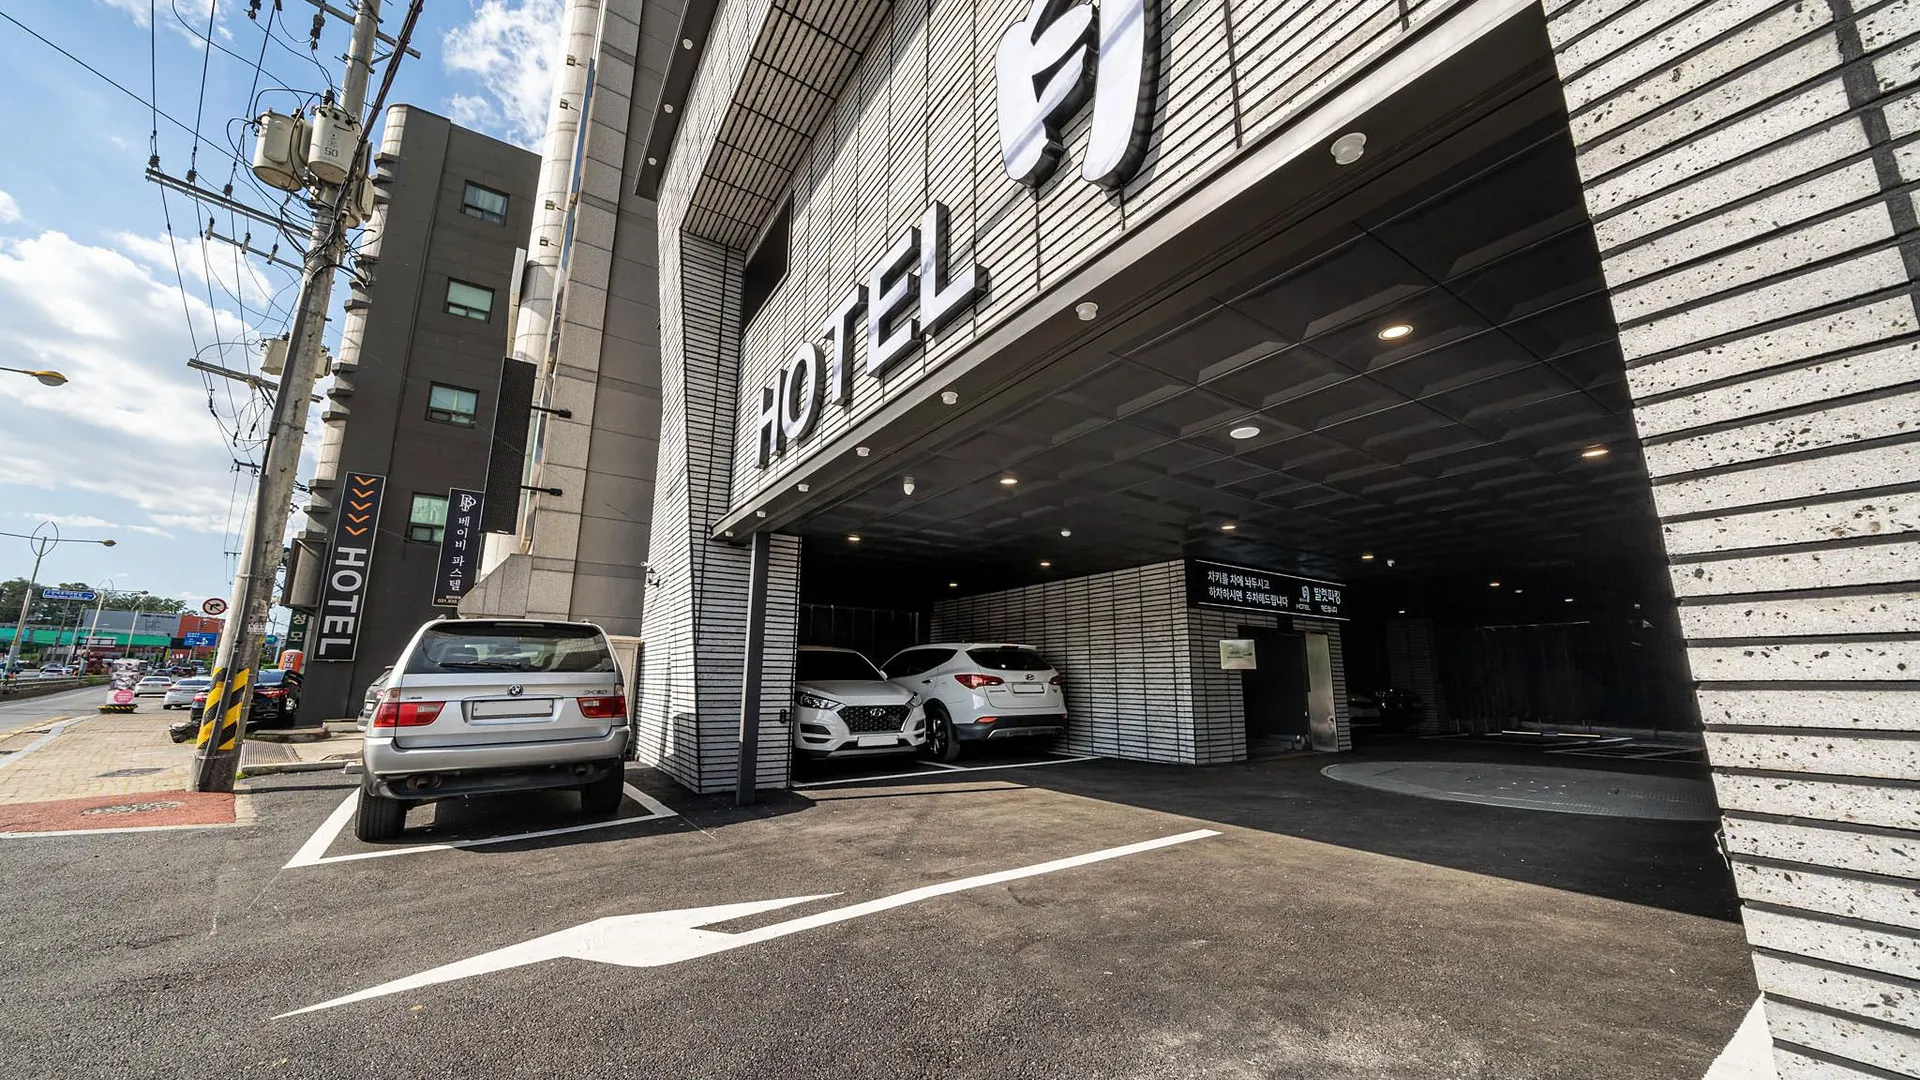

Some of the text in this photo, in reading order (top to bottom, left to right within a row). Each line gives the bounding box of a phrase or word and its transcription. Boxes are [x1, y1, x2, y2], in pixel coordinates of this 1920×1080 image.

[324, 146, 339, 157] 50
[755, 201, 984, 469] HOTEL
[455, 516, 471, 551] 베이비
[448, 555, 465, 592] 파스텔
[1207, 571, 1229, 586] 차키를
[1230, 574, 1244, 587] 차에
[318, 546, 367, 656] HOTEL
[1208, 586, 1243, 602] 하차하시면
[1245, 592, 1289, 607] 주차해드립니다
[1313, 586, 1342, 605] 발렛파킹
